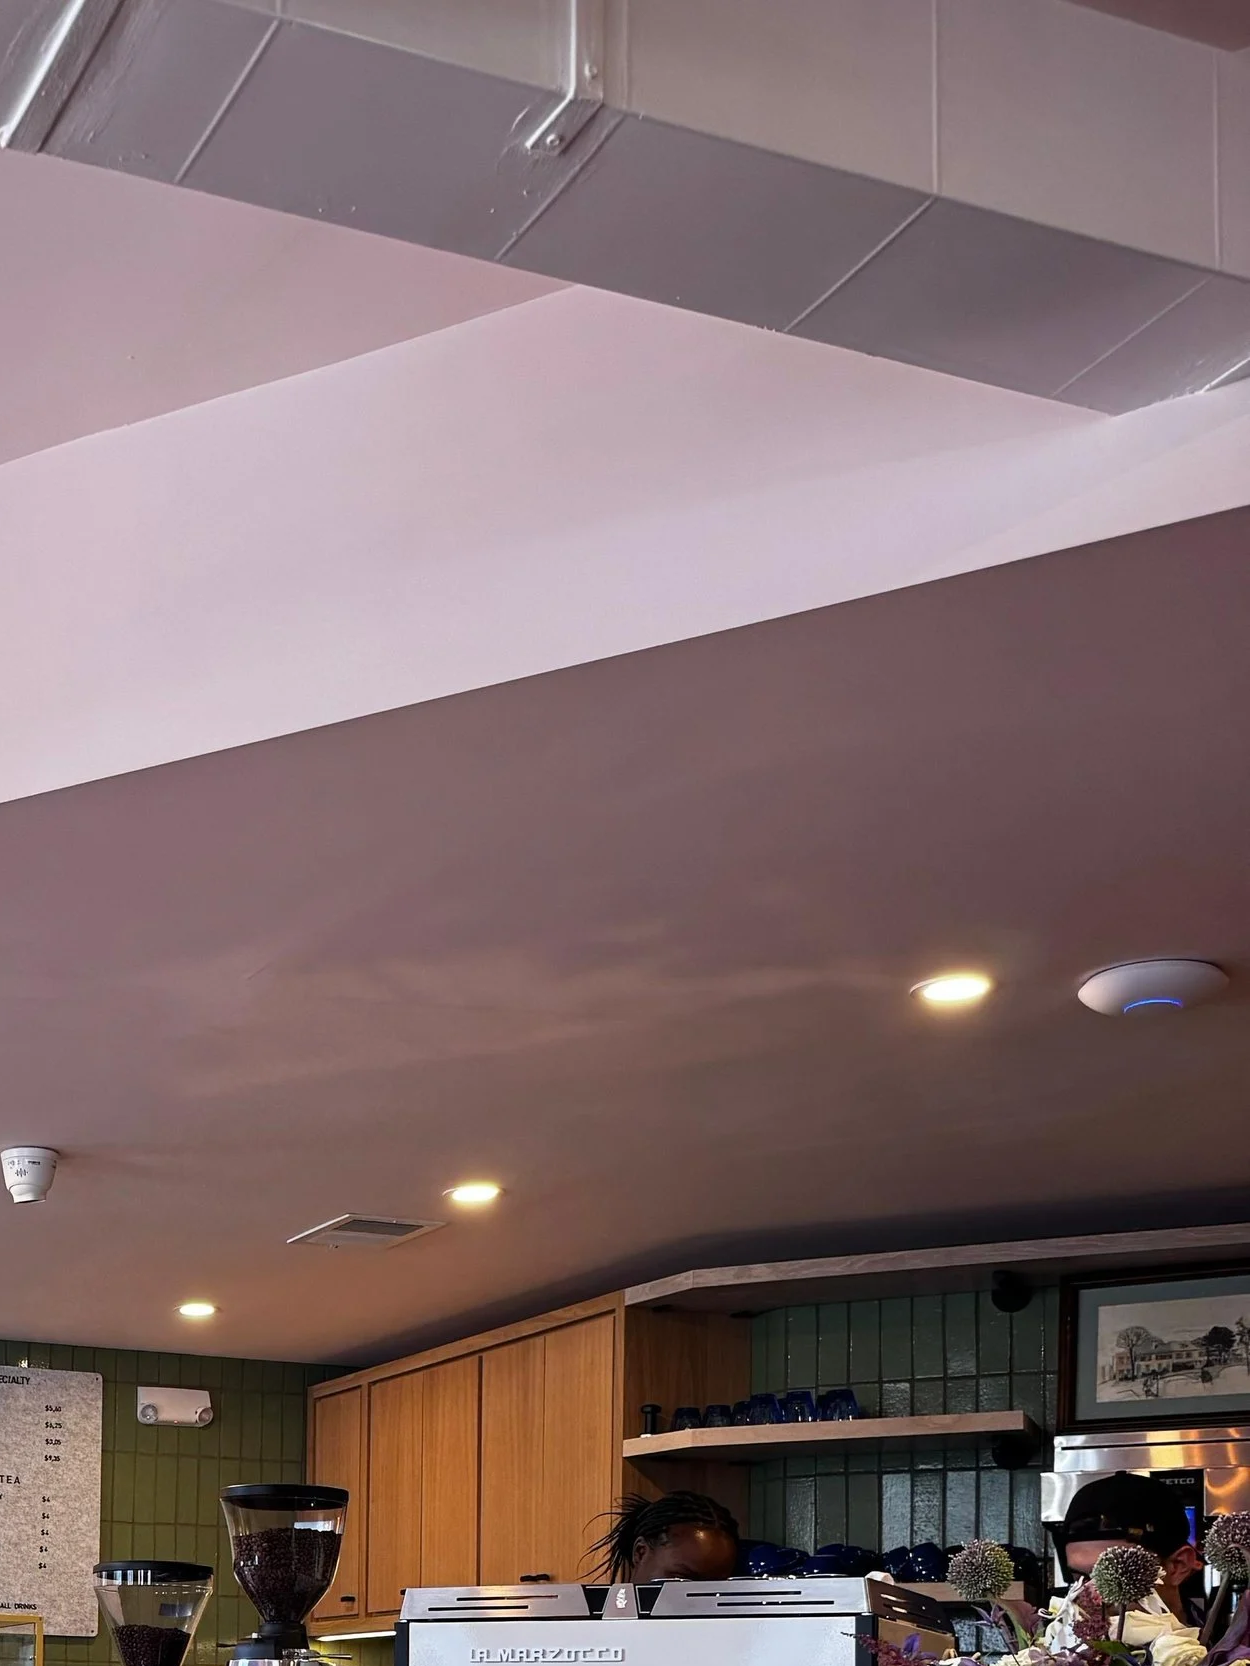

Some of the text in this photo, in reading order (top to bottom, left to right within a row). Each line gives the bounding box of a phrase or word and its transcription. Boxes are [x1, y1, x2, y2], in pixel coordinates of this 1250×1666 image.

[0, 1475, 20, 1484] TEA
[470, 1648, 625, 1663] LA MARZOCCO
